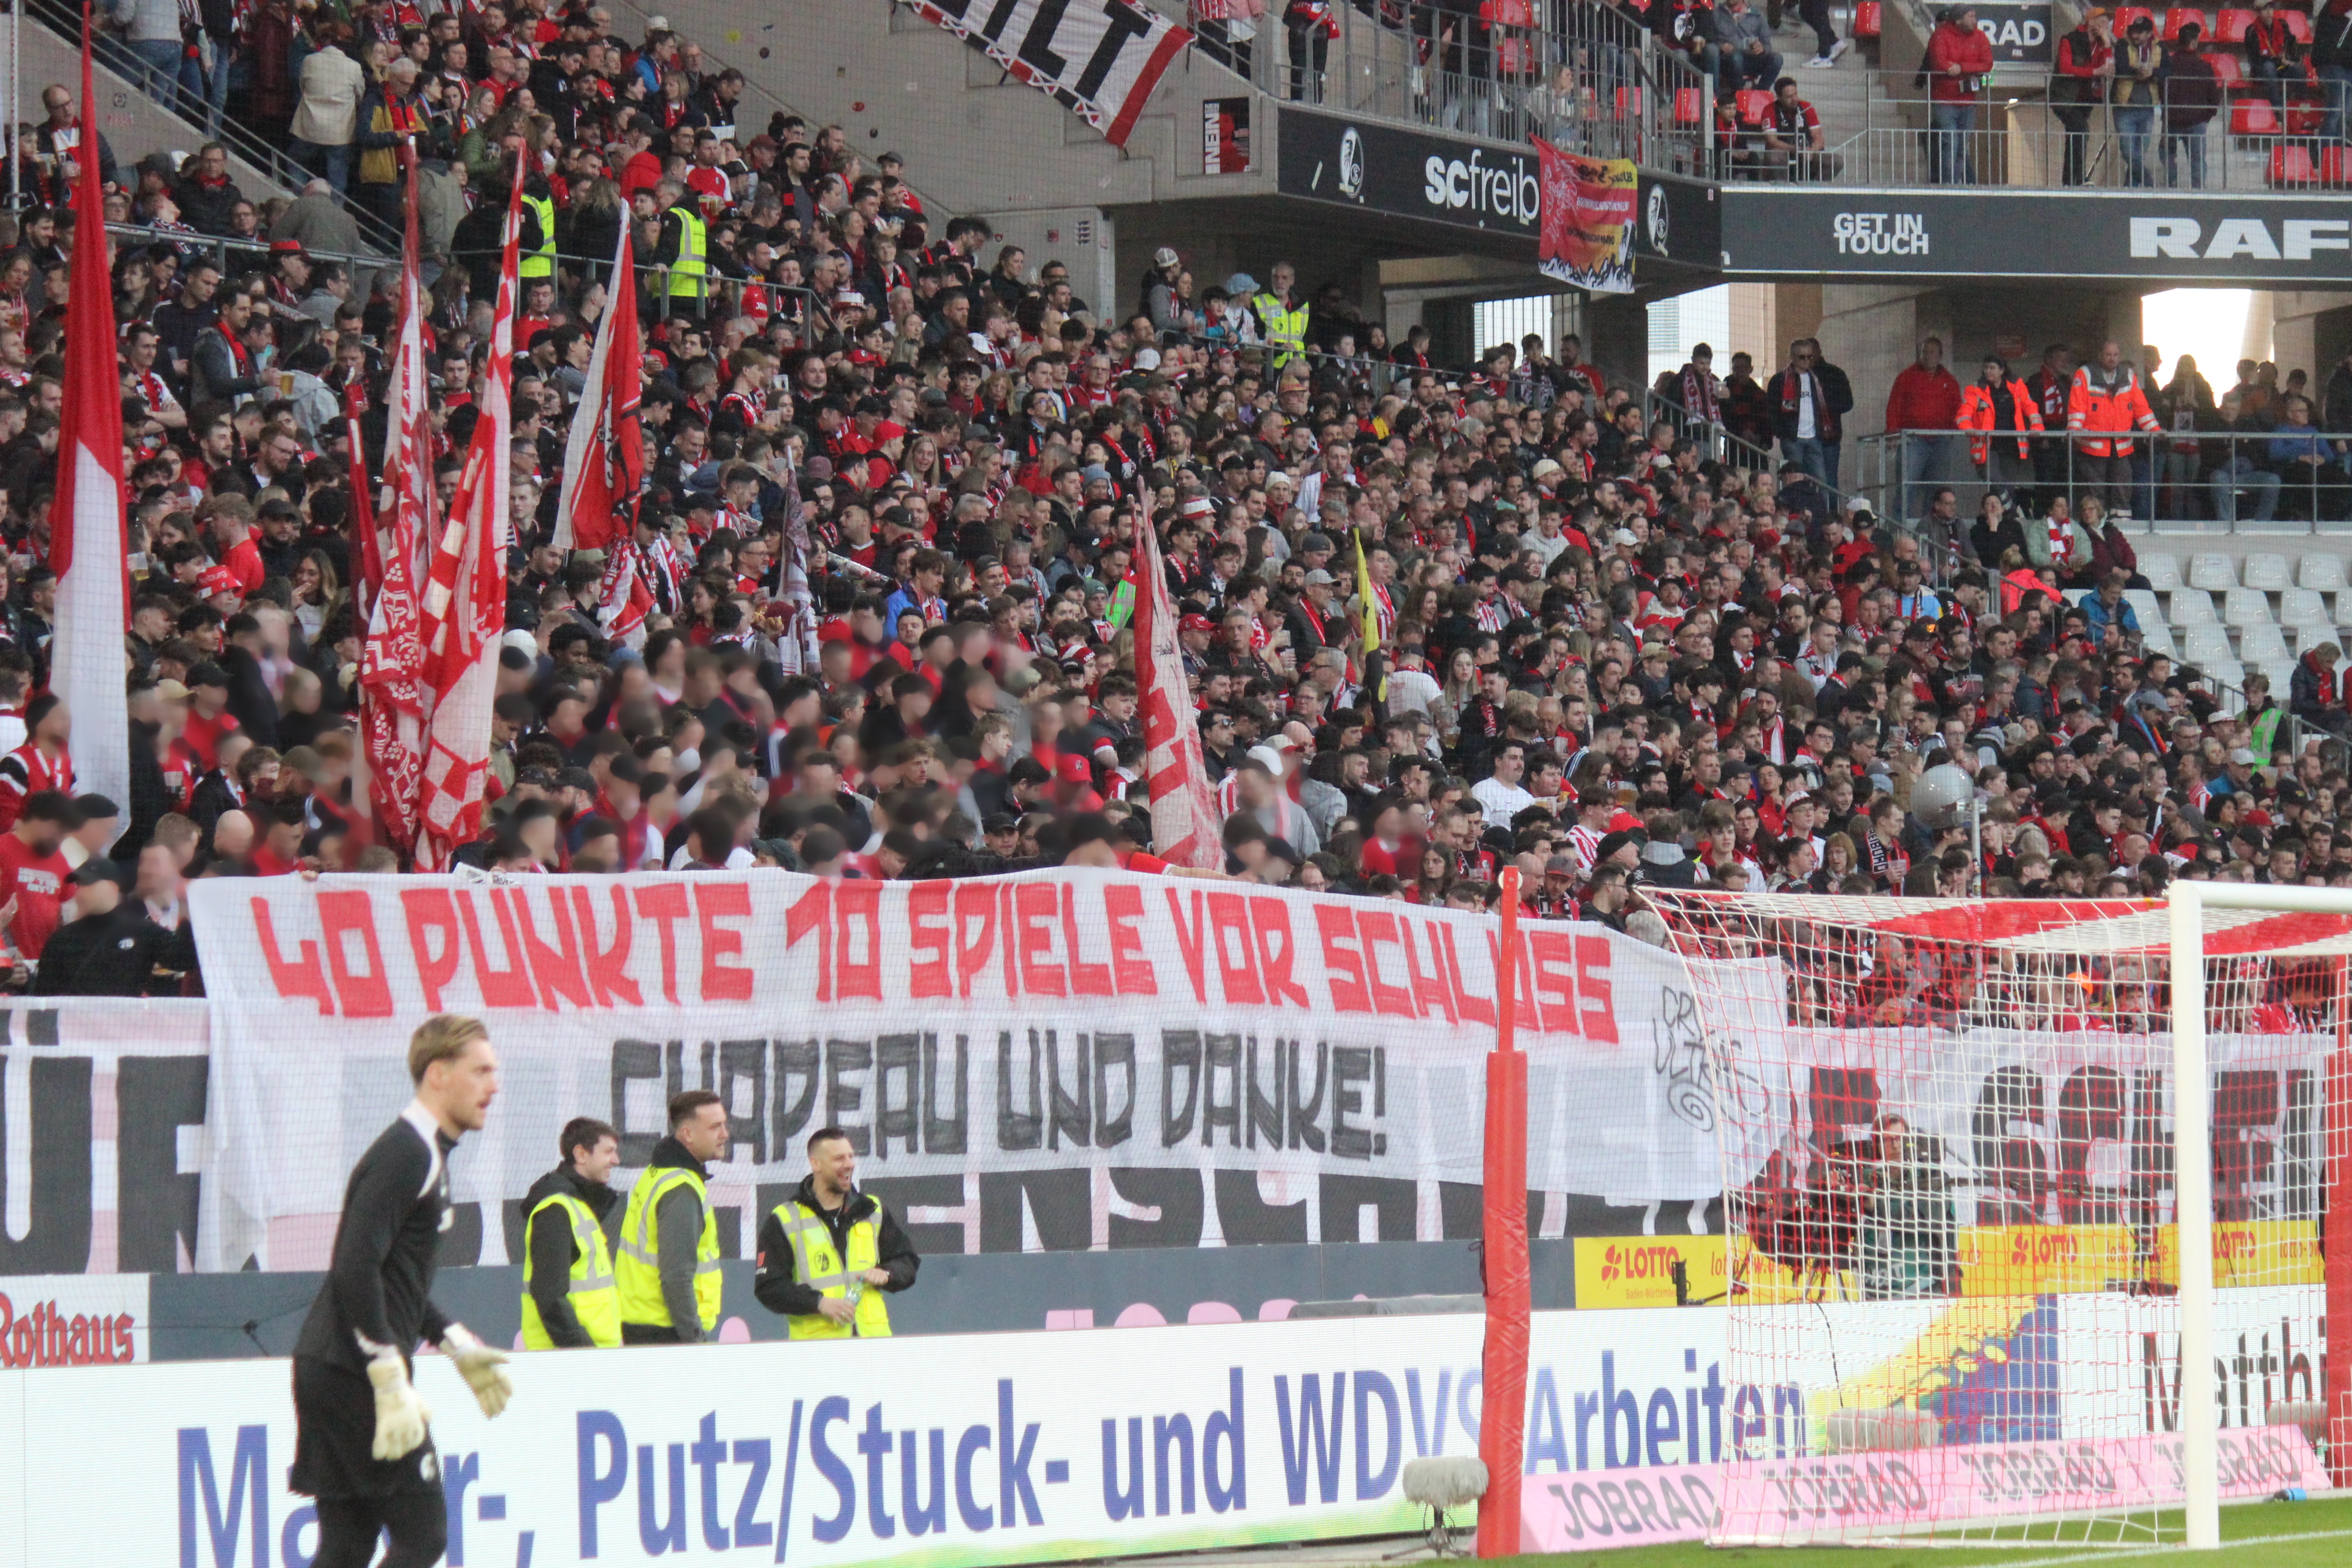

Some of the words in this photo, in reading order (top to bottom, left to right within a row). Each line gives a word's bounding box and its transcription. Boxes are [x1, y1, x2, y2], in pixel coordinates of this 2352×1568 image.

[1833, 212, 1888, 235] GET
[1895, 213, 1922, 235] IN
[1833, 232, 1929, 255] TOUCH
[250, 890, 393, 1018] 40
[400, 882, 754, 1013] PUNKTE
[786, 877, 882, 1002] 10
[908, 879, 1158, 1008] SPIELE
[1165, 887, 1309, 1010] VOR
[1313, 903, 1619, 1044] SCHLUSS
[612, 1029, 969, 1168] CHAPEAU
[999, 1026, 1136, 1152] UND
[1161, 1028, 1387, 1161] DANKE!
[1625, 1246, 1680, 1279] LOTTO
[2031, 1234, 2078, 1264] LOTTO
[0, 1291, 135, 1367] Rothaus
[576, 1377, 1069, 1564] Putz/Stuck-
[1101, 1366, 1247, 1521] und
[1525, 1348, 1806, 1475] Arbeiten
[1962, 1444, 2117, 1504] JOBRAD
[2153, 1435, 2302, 1492] JRAD
[1548, 1475, 1723, 1539] JOBRAD
[1761, 1460, 1927, 1521] JOBRAD
